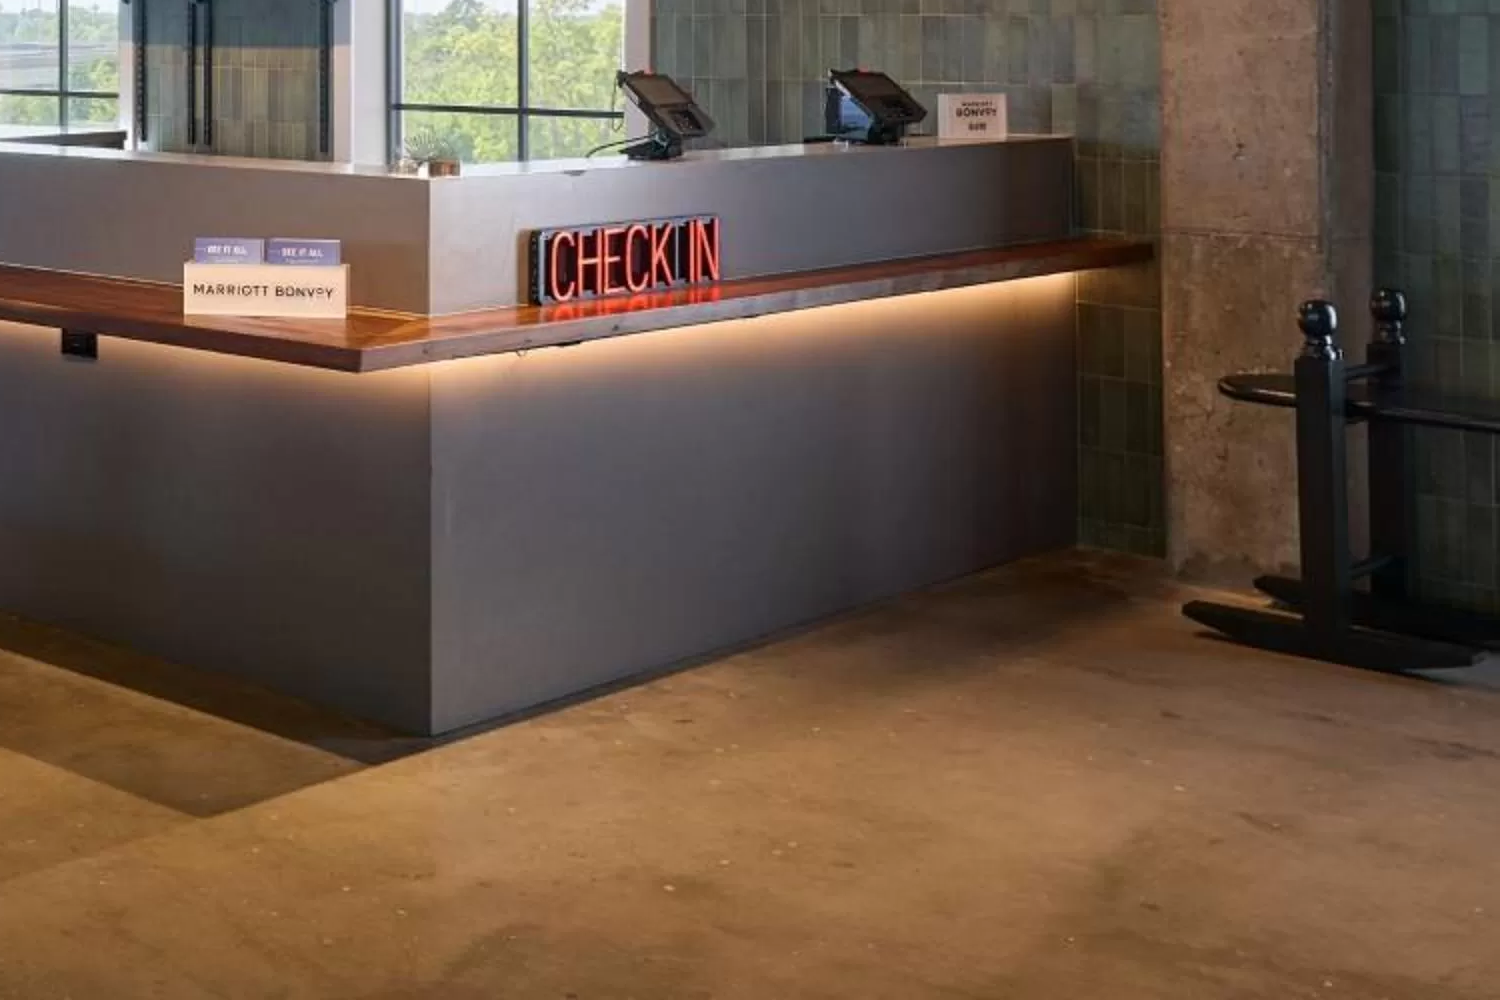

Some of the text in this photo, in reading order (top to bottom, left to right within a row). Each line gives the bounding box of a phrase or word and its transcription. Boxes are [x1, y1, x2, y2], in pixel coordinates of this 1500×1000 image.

[550, 215, 721, 303] CHECK IN
[193, 283, 334, 299] MARRIOTT BONVOY
